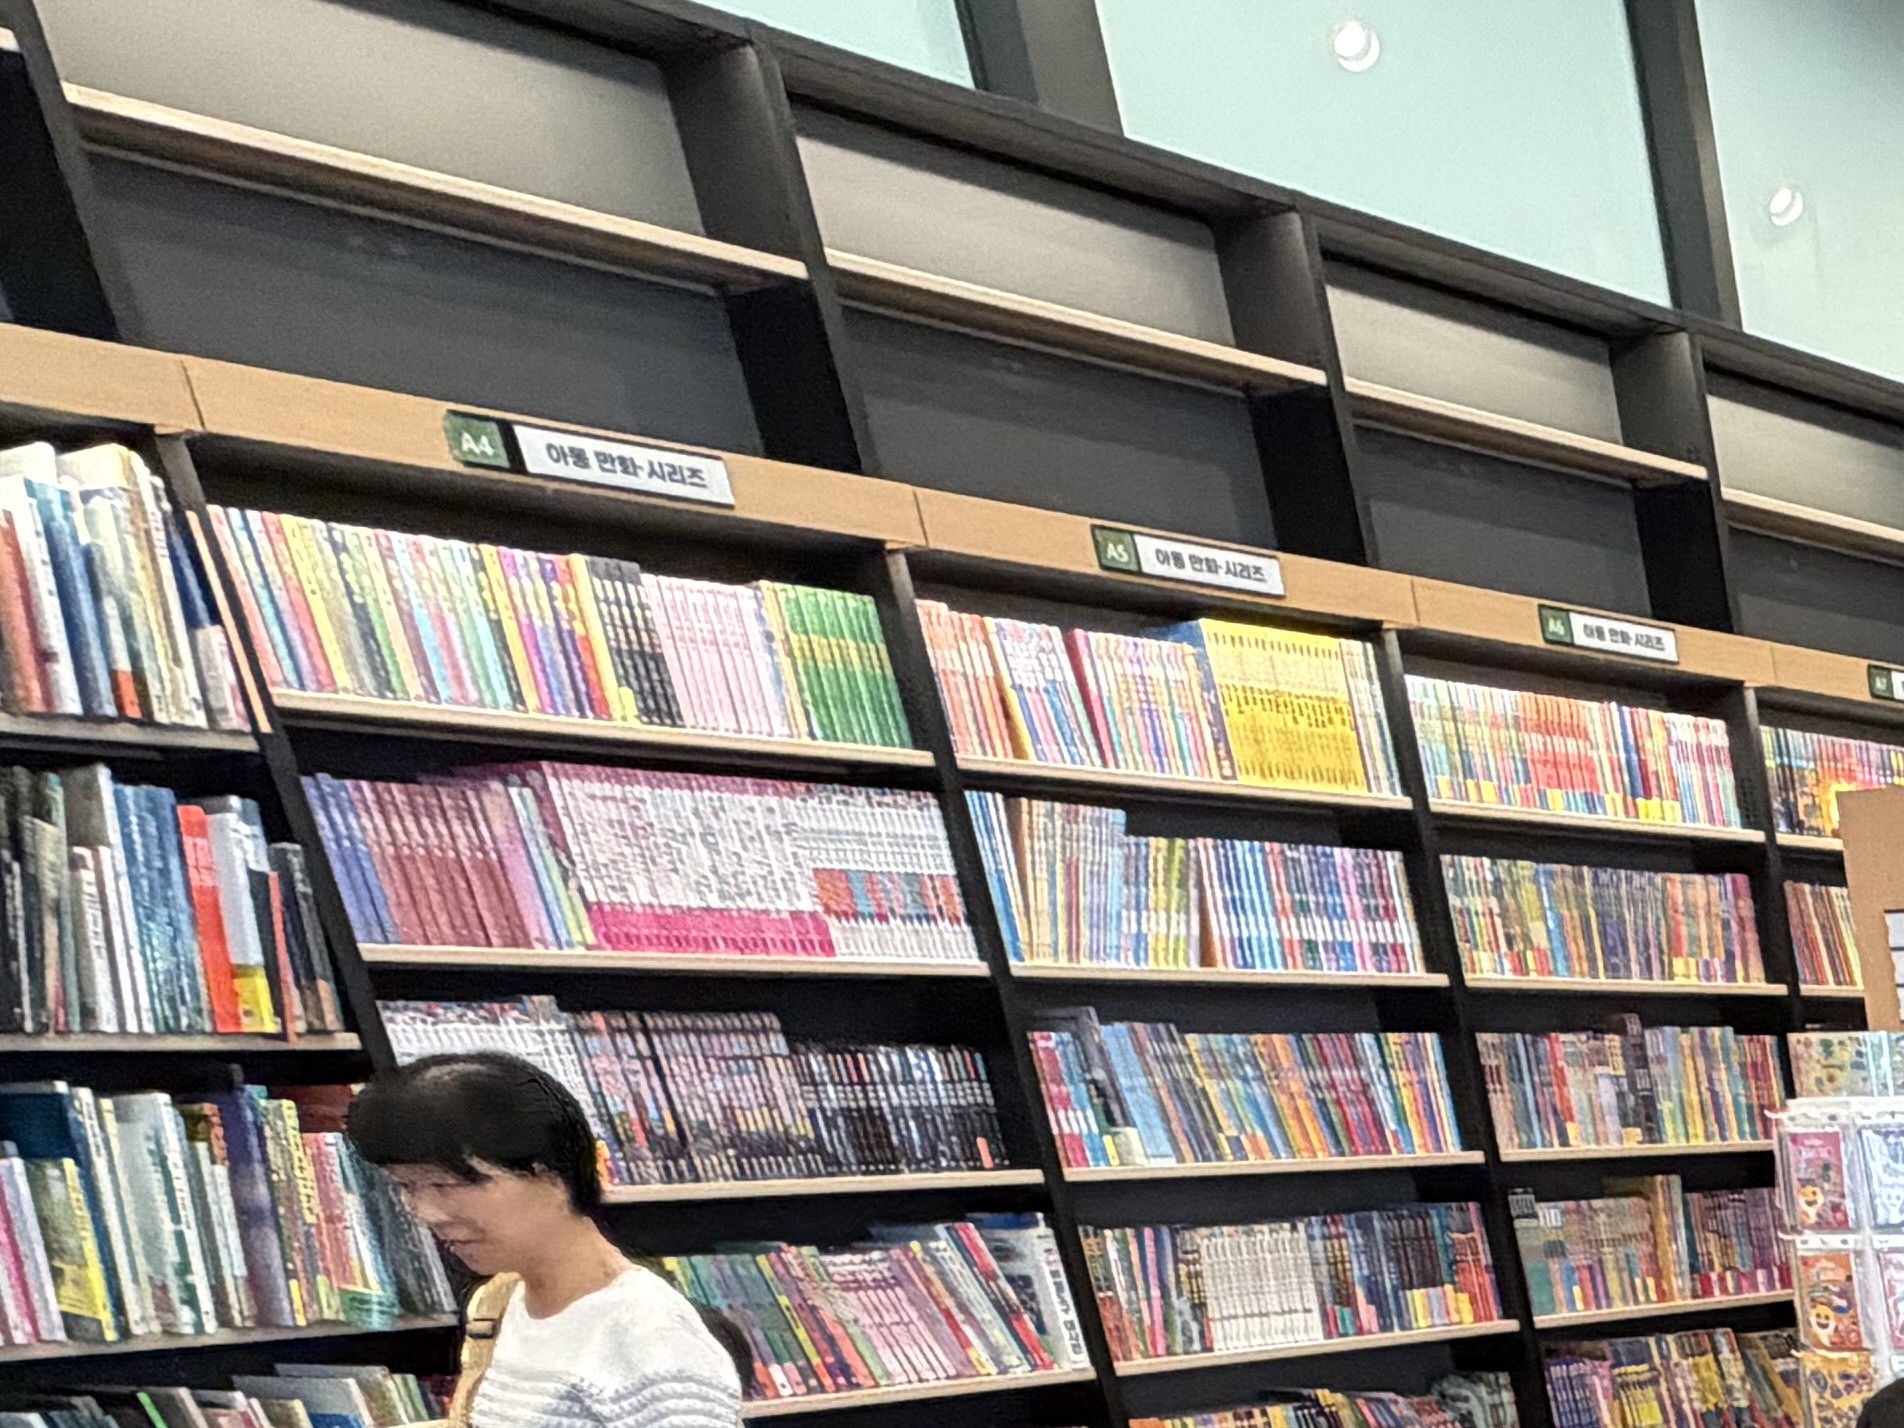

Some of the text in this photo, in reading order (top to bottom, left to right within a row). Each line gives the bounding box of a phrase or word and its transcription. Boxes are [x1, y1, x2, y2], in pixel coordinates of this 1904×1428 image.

[460, 431, 493, 456] A4
[546, 443, 590, 469] 아동
[1107, 542, 1129, 563] A5
